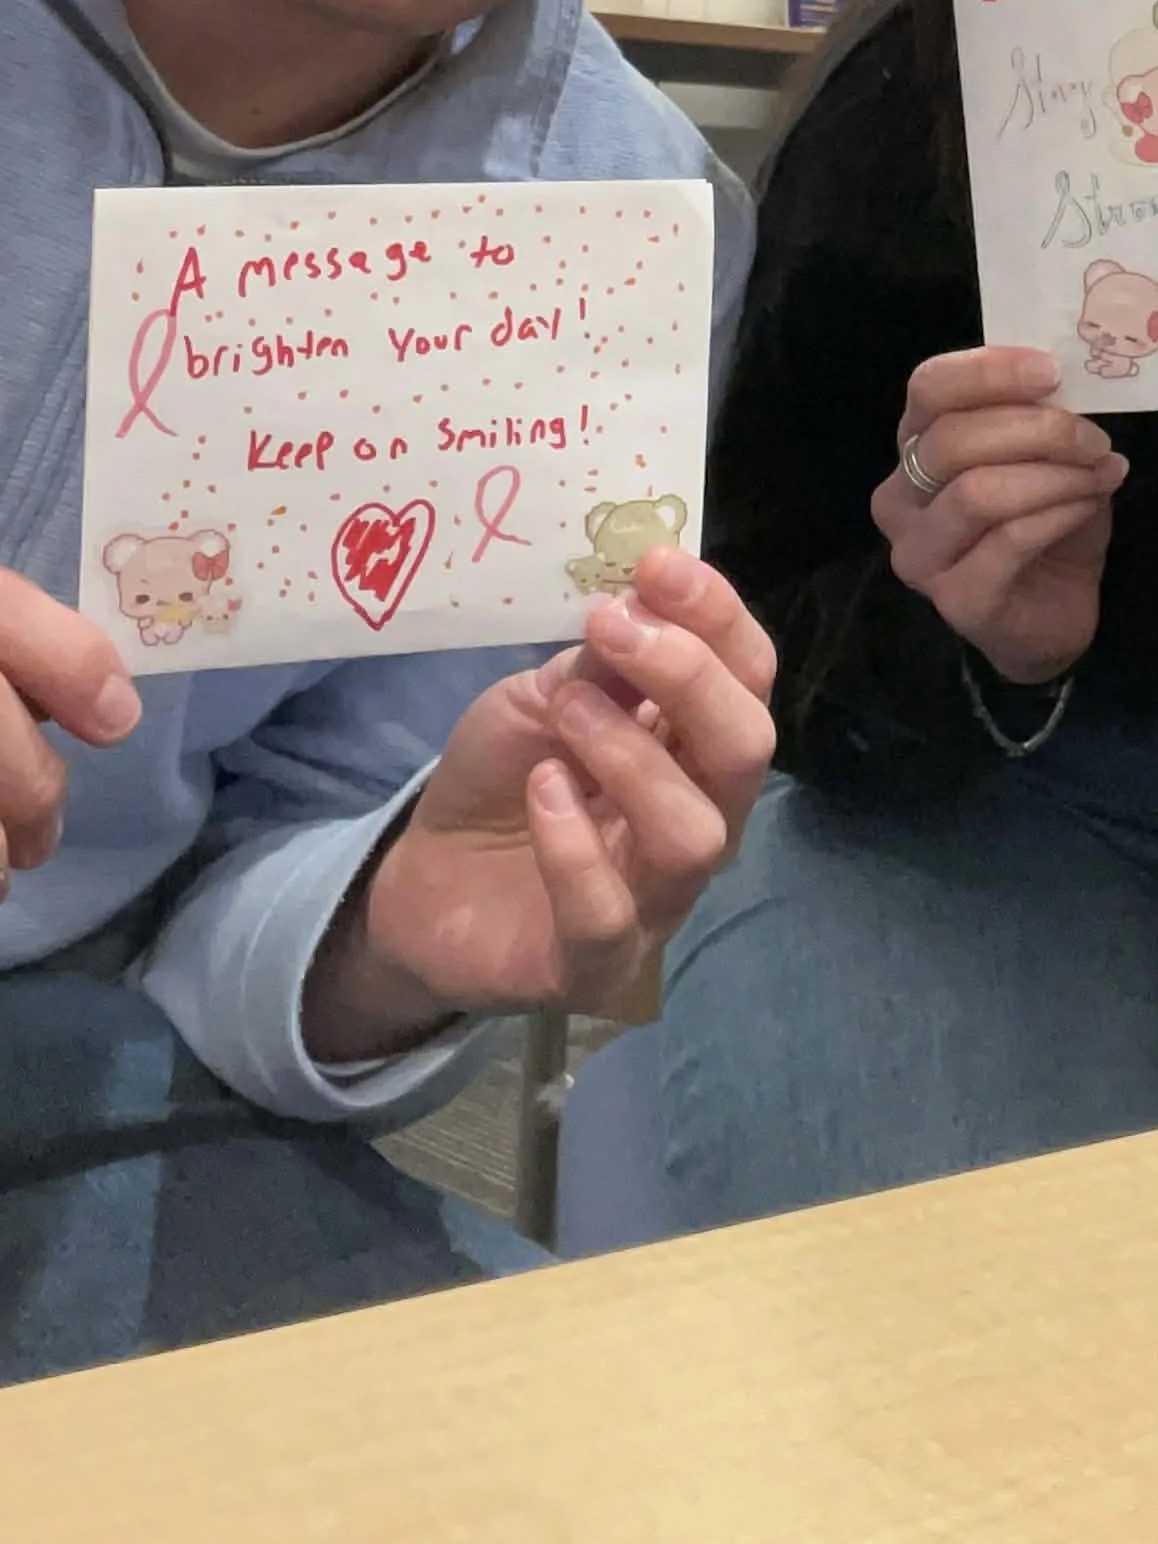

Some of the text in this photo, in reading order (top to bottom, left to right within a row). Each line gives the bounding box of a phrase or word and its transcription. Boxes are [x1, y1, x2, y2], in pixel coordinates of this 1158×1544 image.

[168, 246, 207, 317] A
[470, 235, 516, 268] to
[183, 330, 350, 378] brighten
[353, 436, 408, 461] on
